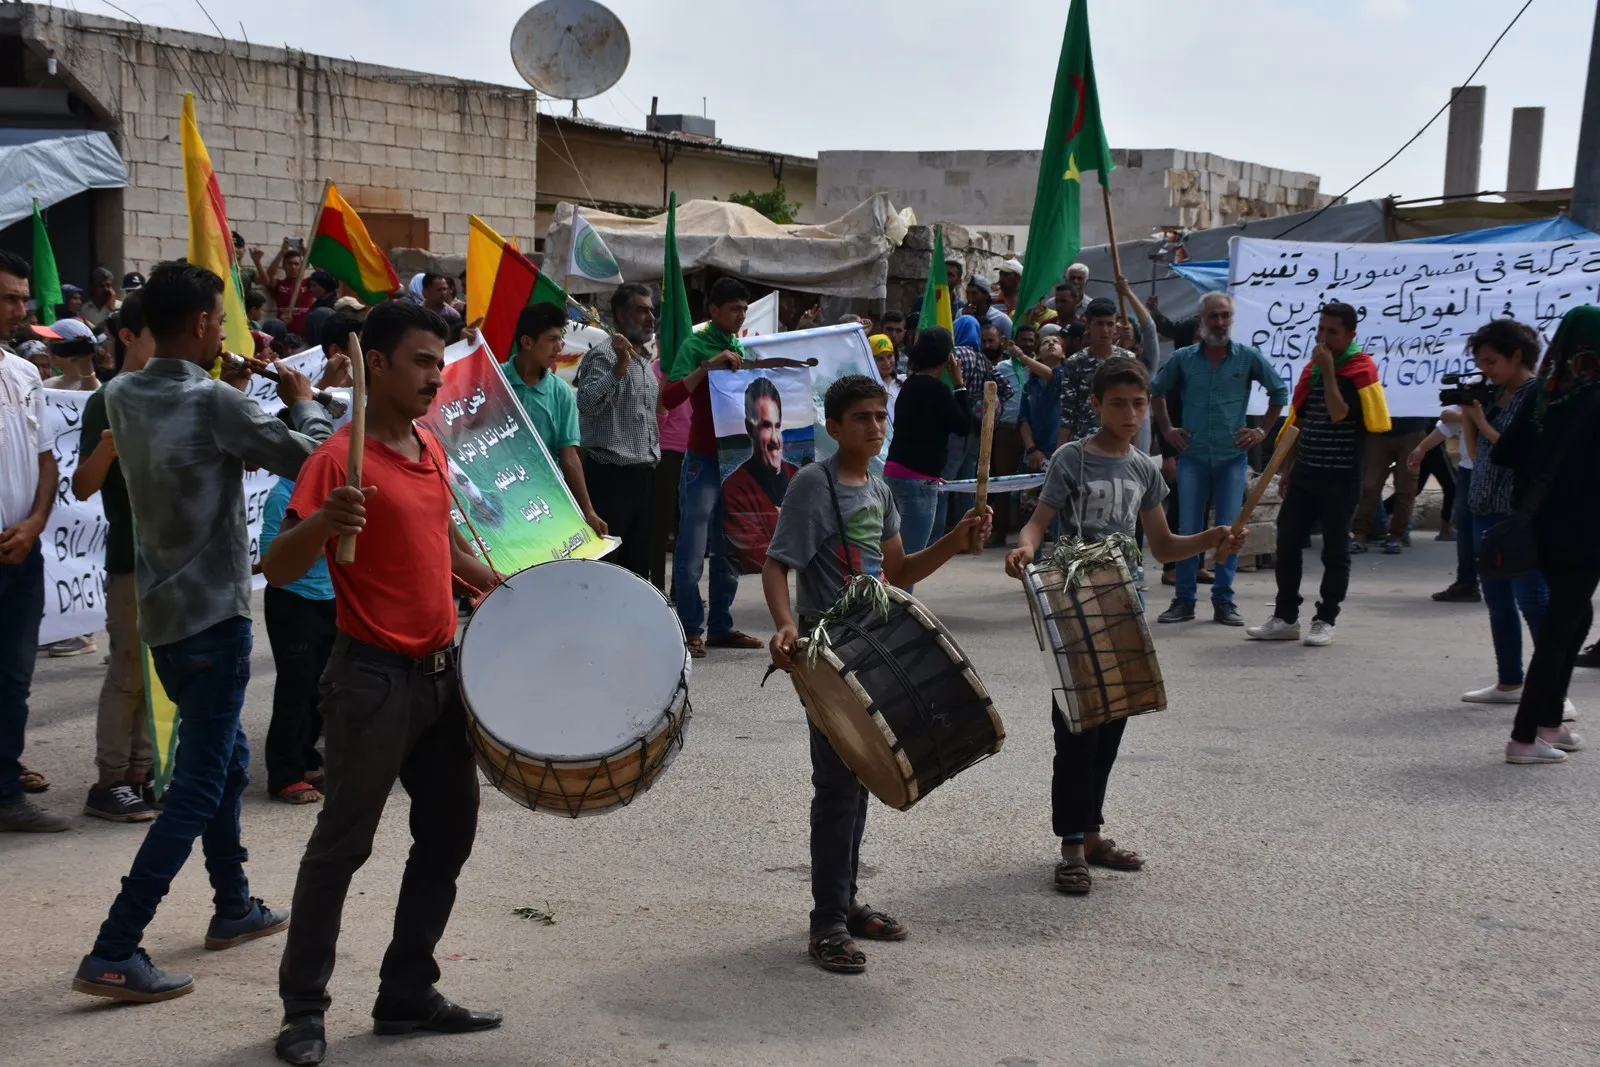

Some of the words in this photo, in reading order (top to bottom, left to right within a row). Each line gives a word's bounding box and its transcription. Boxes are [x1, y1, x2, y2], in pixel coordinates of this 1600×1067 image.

[1326, 252, 1407, 290] سوريا
[464, 387, 486, 414] نحن
[474, 436, 489, 459] في
[536, 494, 553, 518] في
